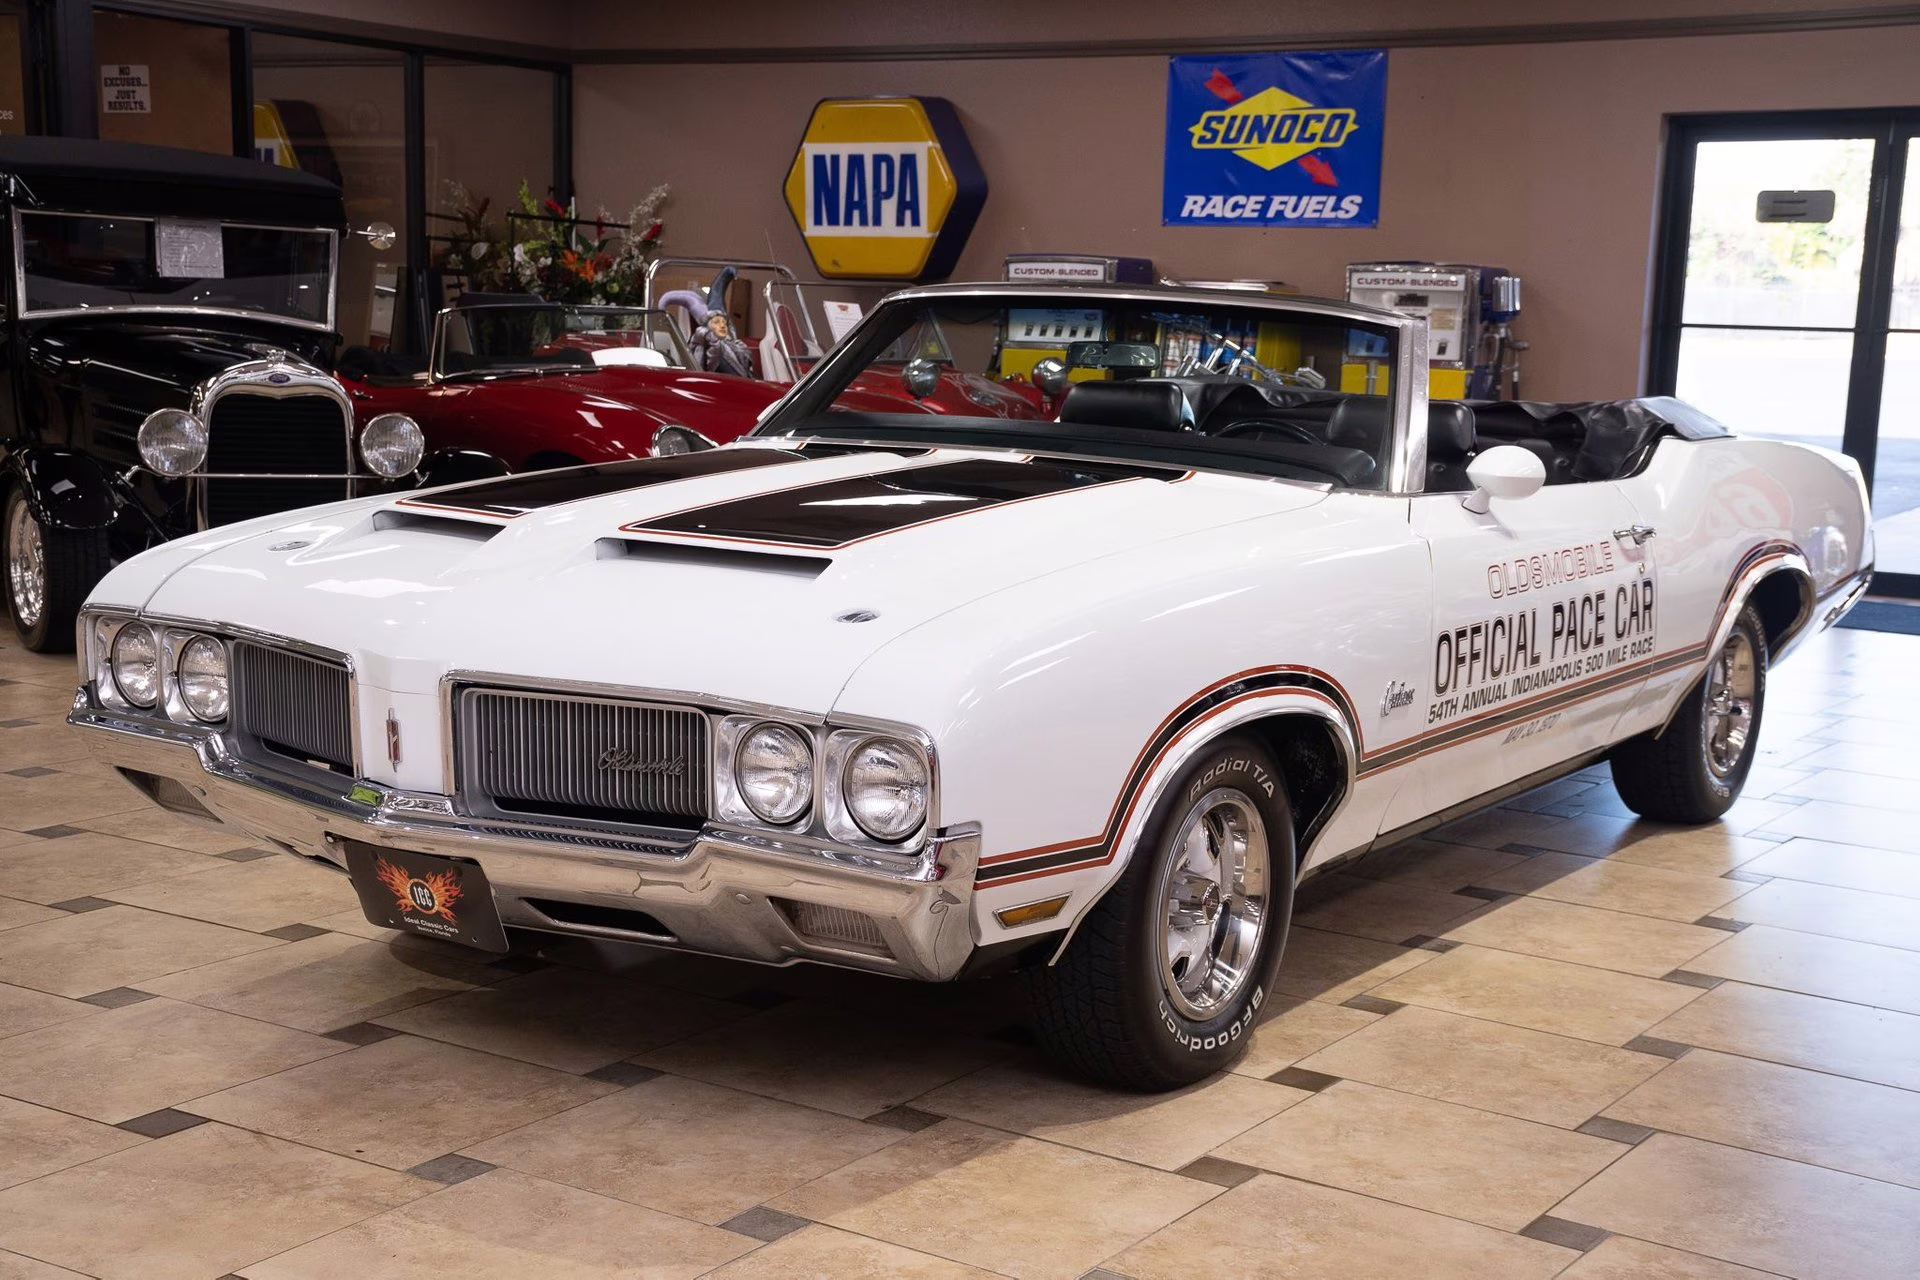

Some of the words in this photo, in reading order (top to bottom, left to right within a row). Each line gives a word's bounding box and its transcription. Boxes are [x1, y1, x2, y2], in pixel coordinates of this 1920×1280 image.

[119, 66, 130, 76] NO
[115, 90, 136, 100] JUST
[1197, 113, 1350, 145] SUNOCO
[813, 153, 921, 227] NAPA
[1180, 195, 1266, 218] RACE
[1266, 195, 1363, 219] FUELS
[1014, 267, 1099, 276] CUSTOM-BLENDED
[1357, 277, 1459, 287] CUSTOM-BLENDED
[1487, 541, 1615, 599] OLDSMOBILE
[1435, 608, 1541, 698] OFFICIAL
[1550, 590, 1606, 662] PACE
[1615, 578, 1655, 641] CAR
[1428, 696, 1459, 724] 54TH
[1461, 683, 1508, 713] ANNUAL
[1511, 660, 1582, 697] INDIANAPOLIS
[1585, 653, 1604, 674] 500
[1606, 645, 1628, 668] MILE
[1630, 636, 1654, 658] RACE
[1189, 757, 1251, 802] Radial
[1253, 764, 1275, 798] T/A
[413, 885, 433, 907] ICC
[403, 916, 420, 925] Ideal
[420, 919, 443, 930] Classic
[444, 924, 459, 934] Cars
[1159, 985, 1264, 1052] BFGoodrich
